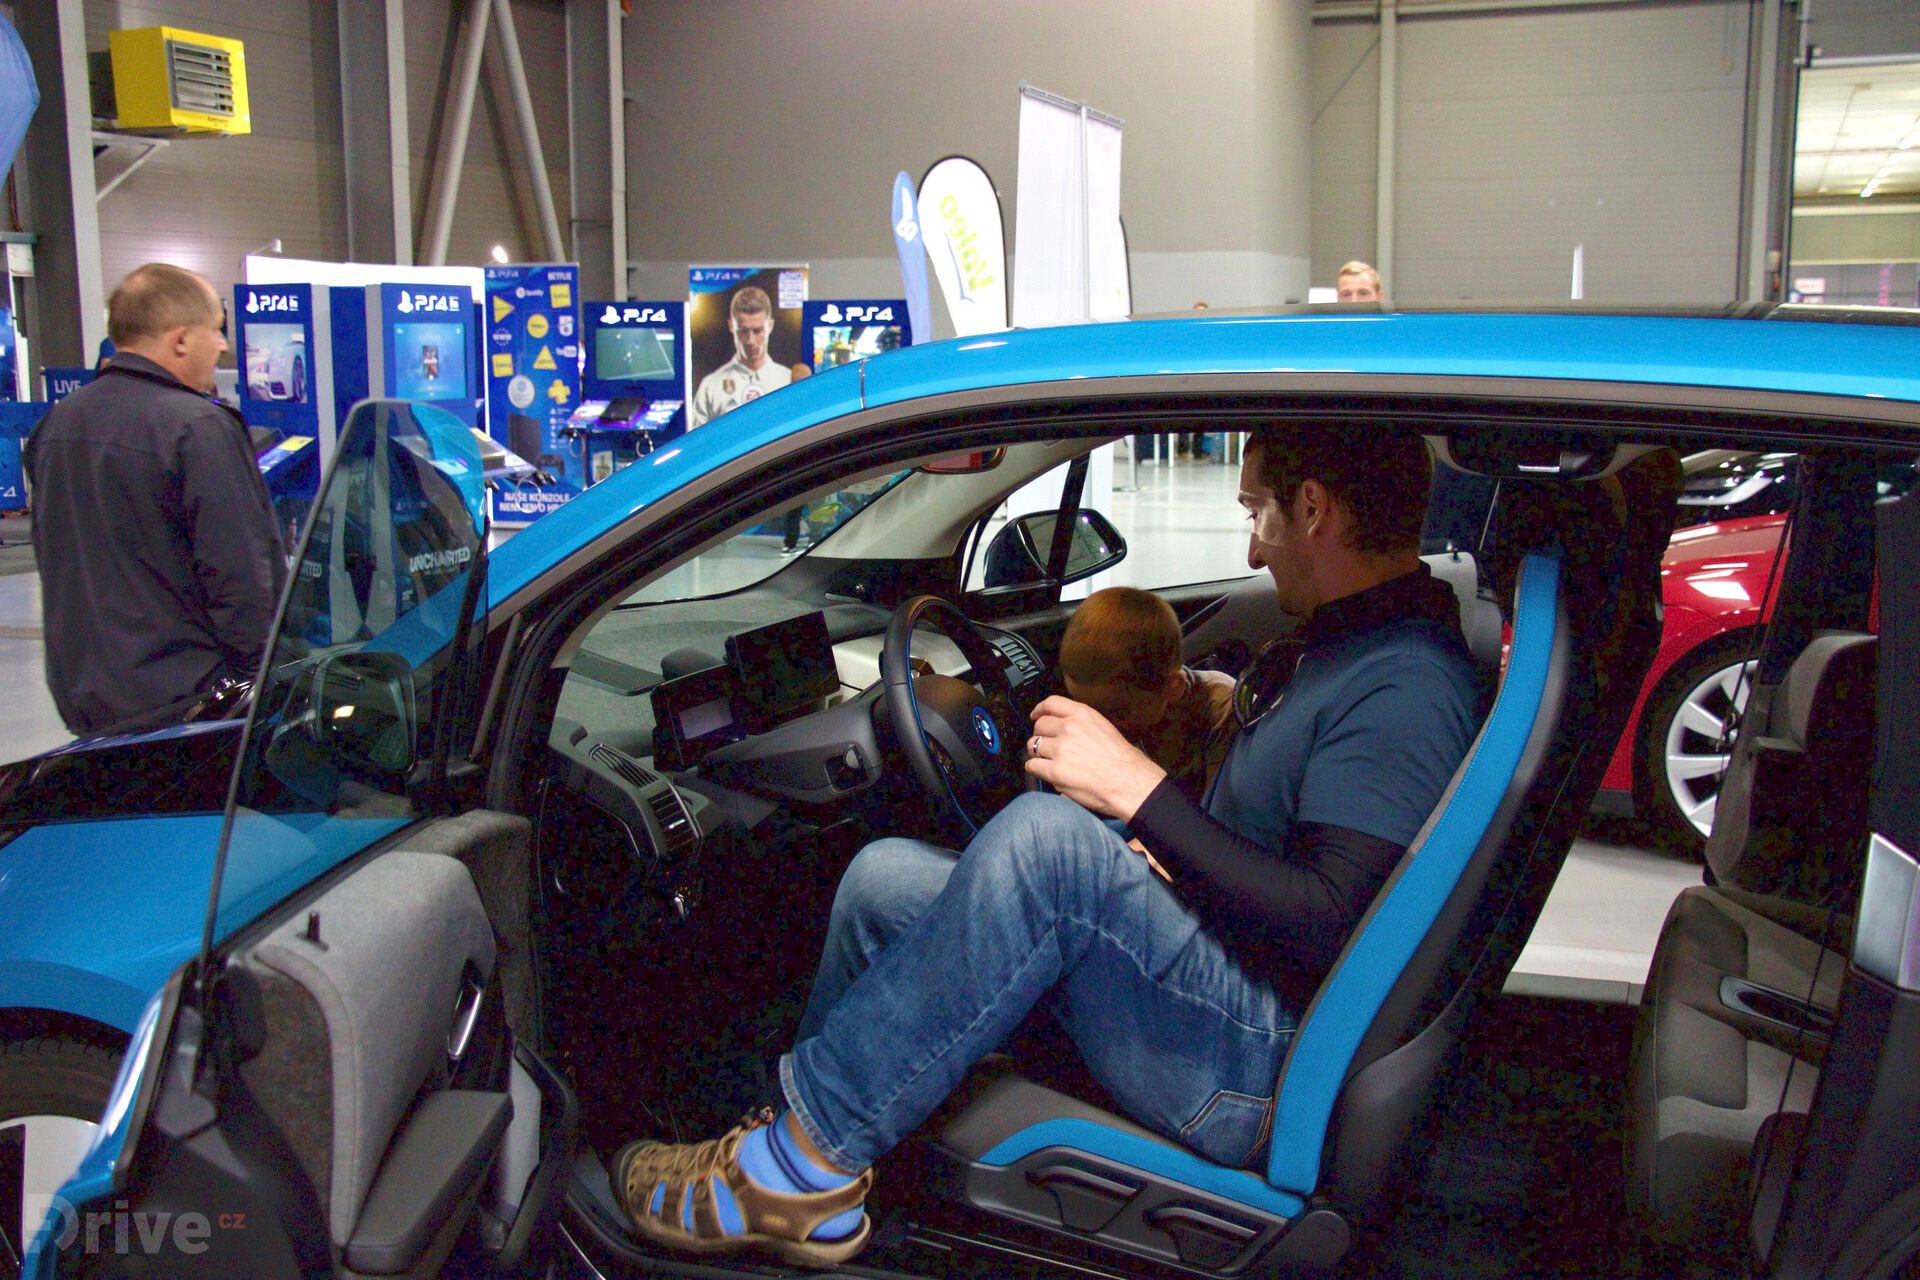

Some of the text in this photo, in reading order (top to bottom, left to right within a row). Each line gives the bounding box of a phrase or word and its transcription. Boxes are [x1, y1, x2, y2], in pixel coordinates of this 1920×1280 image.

[260, 294, 288, 312] PS4
[415, 294, 449, 312] PS4
[623, 308, 668, 323] PS4
[846, 306, 893, 322] PS4
[410, 546, 472, 572] UNCHARTED
